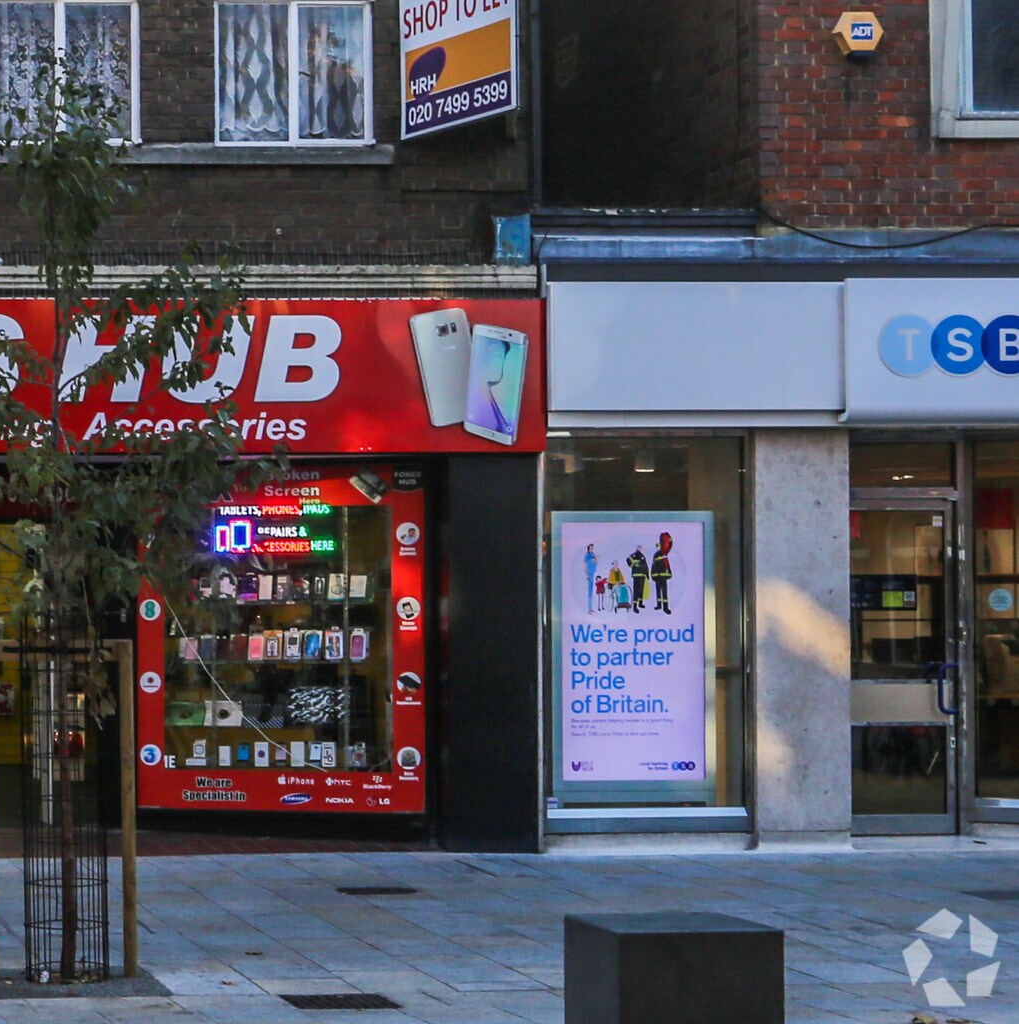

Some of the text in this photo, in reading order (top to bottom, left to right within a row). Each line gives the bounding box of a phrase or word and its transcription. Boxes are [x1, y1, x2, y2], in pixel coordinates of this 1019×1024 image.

[852, 26, 873, 37] ADT
[410, 73, 437, 95] HRH
[408, 80, 508, 126] 020 7499 5399
[898, 327, 1019, 362] TSB
[59, 314, 342, 404] HUB
[268, 469, 320, 480] oken
[264, 485, 320, 496] Screen
[299, 497, 321, 505] Here
[298, 525, 308, 537] &
[310, 539, 335, 551] HERE
[570, 624, 695, 646] We're proud
[570, 648, 674, 670] to partner
[571, 671, 625, 690] Pride
[571, 694, 669, 713] of Britain.
[144, 747, 156, 764] 3
[196, 777, 232, 788] We are
[287, 777, 315, 785] iPhone
[182, 789, 247, 801] Specialist in
